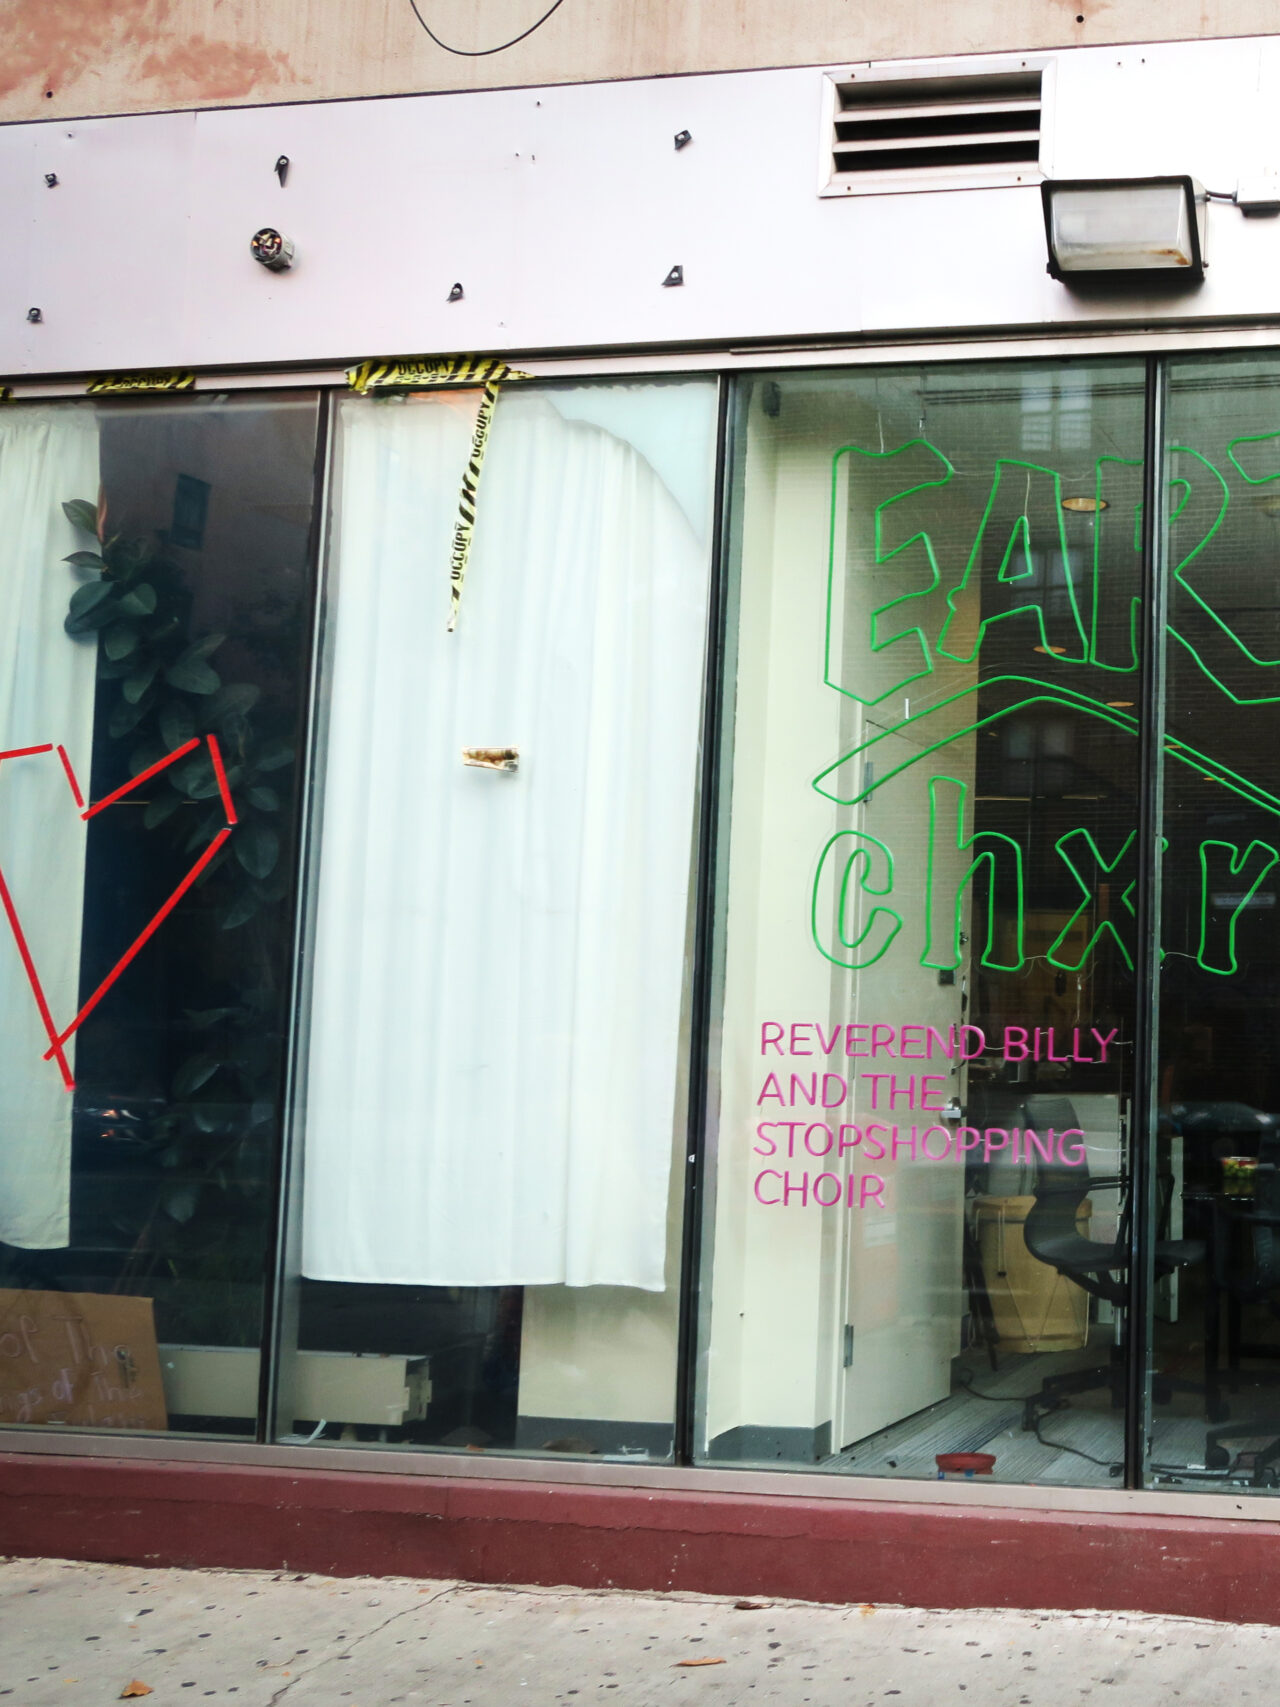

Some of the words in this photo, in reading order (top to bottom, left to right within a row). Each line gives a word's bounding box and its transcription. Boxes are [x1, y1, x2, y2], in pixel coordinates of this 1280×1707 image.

[397, 356, 450, 376] OCCUPY
[471, 402, 491, 458] OCCUPY
[450, 523, 471, 581] OCCUPY
[761, 1022, 985, 1060] REVEREND
[1003, 1026, 1118, 1063] BILLY
[757, 1072, 847, 1108] AND
[861, 1074, 946, 1111] THE
[753, 1121, 1086, 1166] STOPSHOPPING
[754, 1169, 886, 1209] CHOIR
